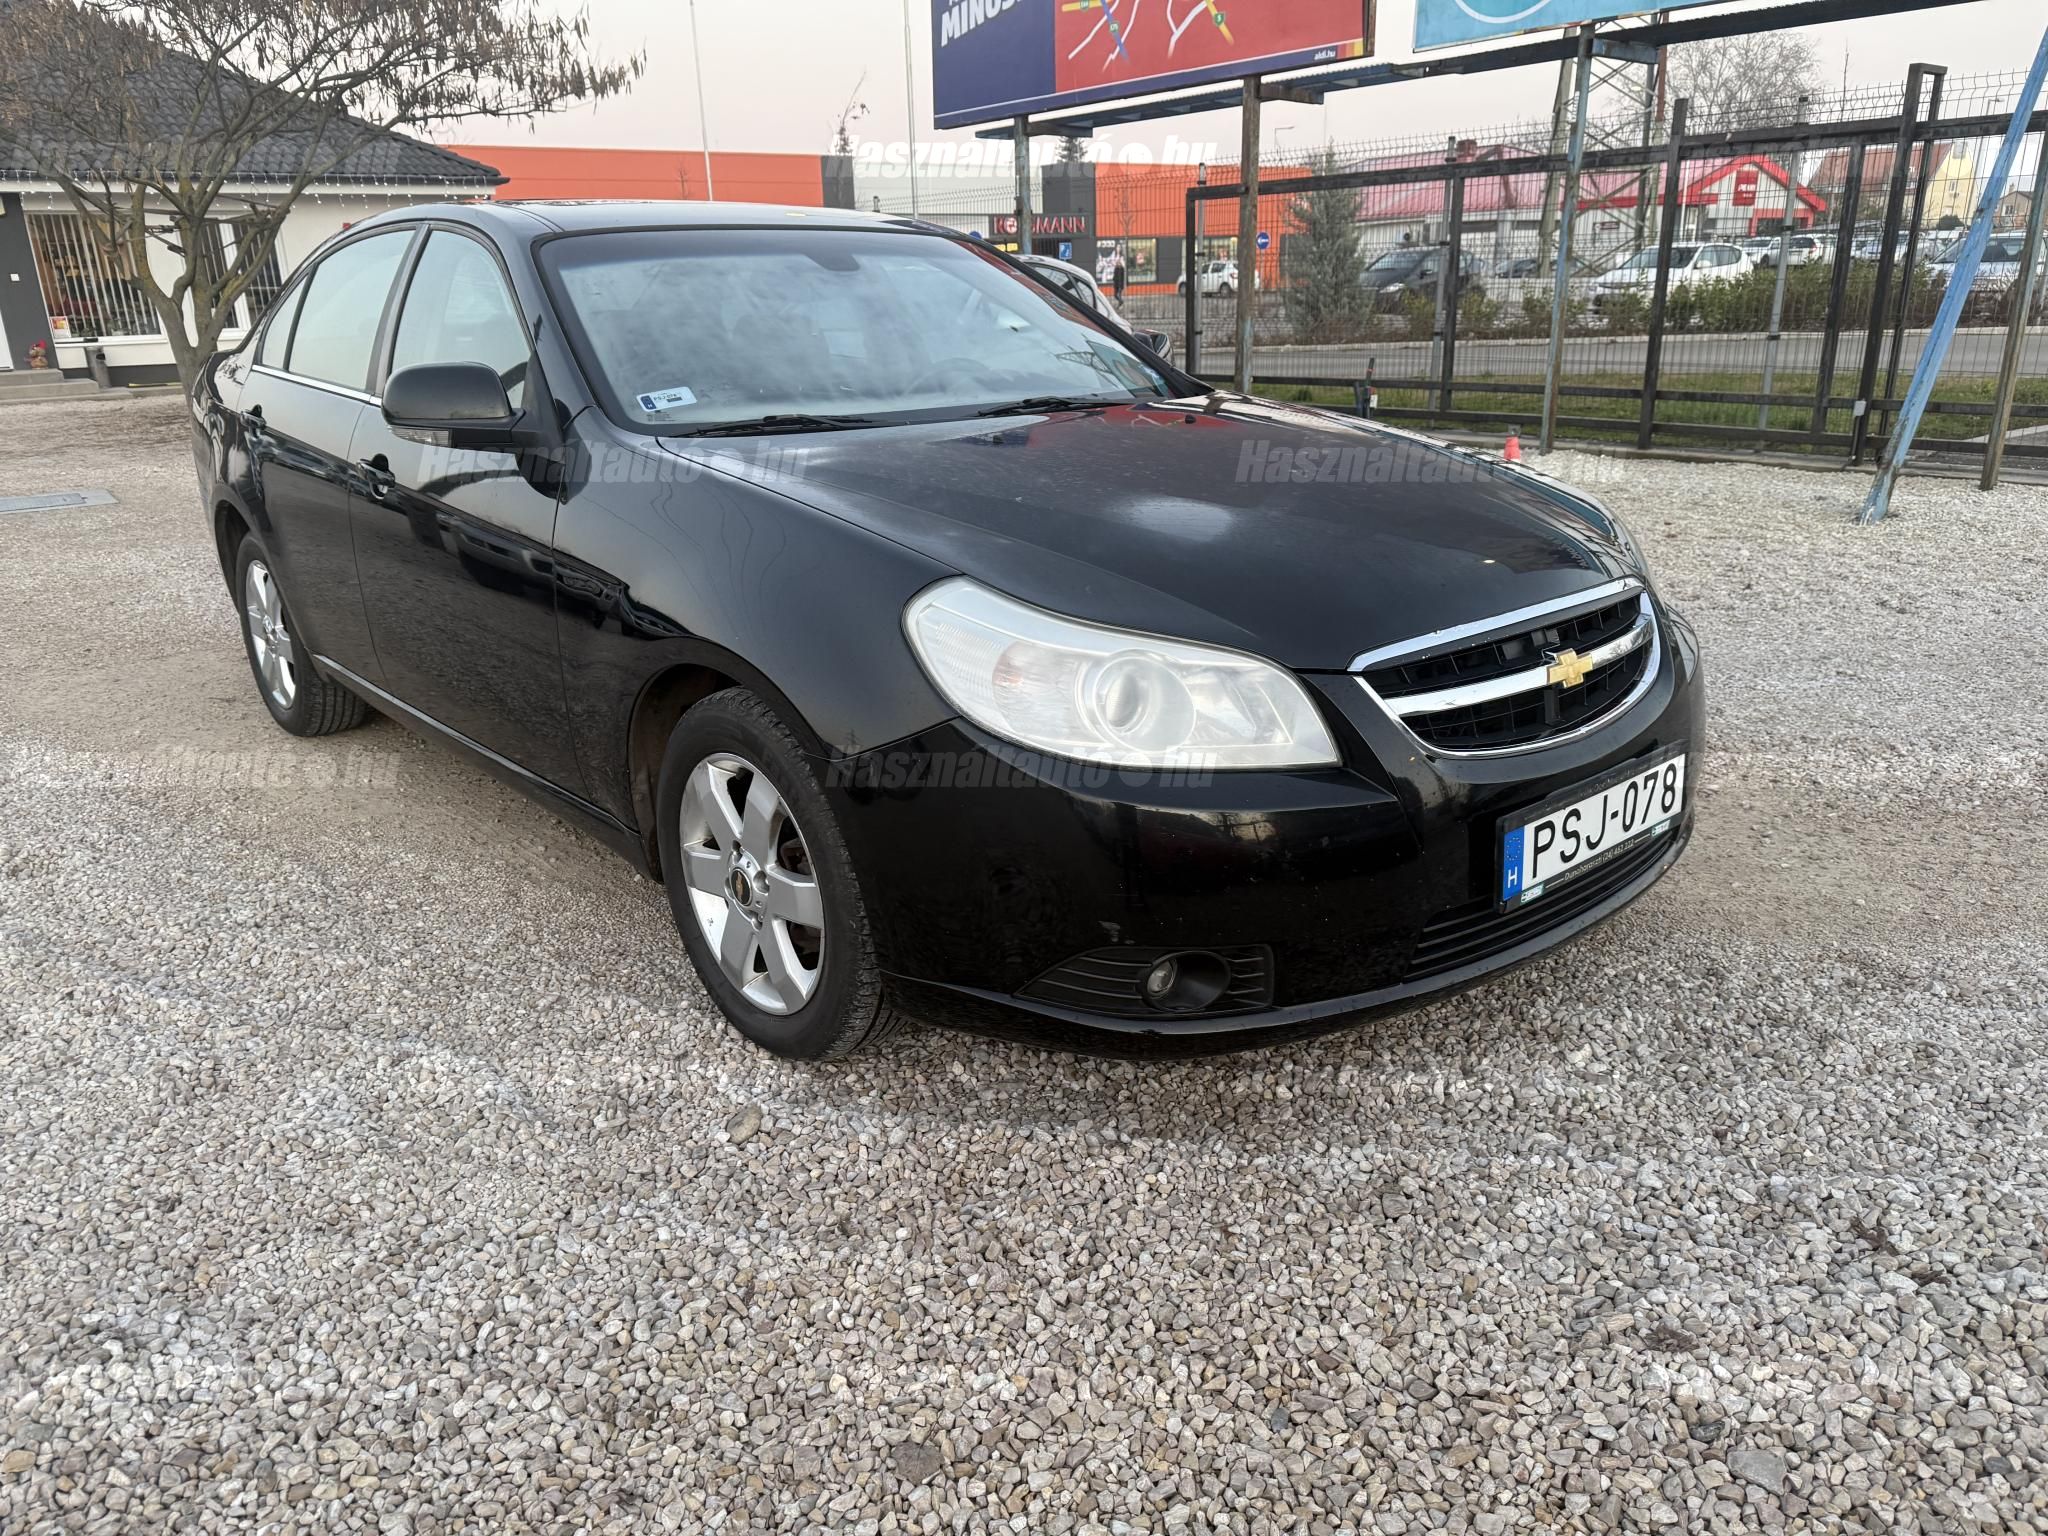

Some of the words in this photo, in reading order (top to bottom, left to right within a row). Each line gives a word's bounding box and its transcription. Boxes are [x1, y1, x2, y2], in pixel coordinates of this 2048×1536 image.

[1313, 49, 1336, 61] aldi.hu
[1532, 763, 1677, 879] PSJ-078
[1507, 866, 1518, 888] H
